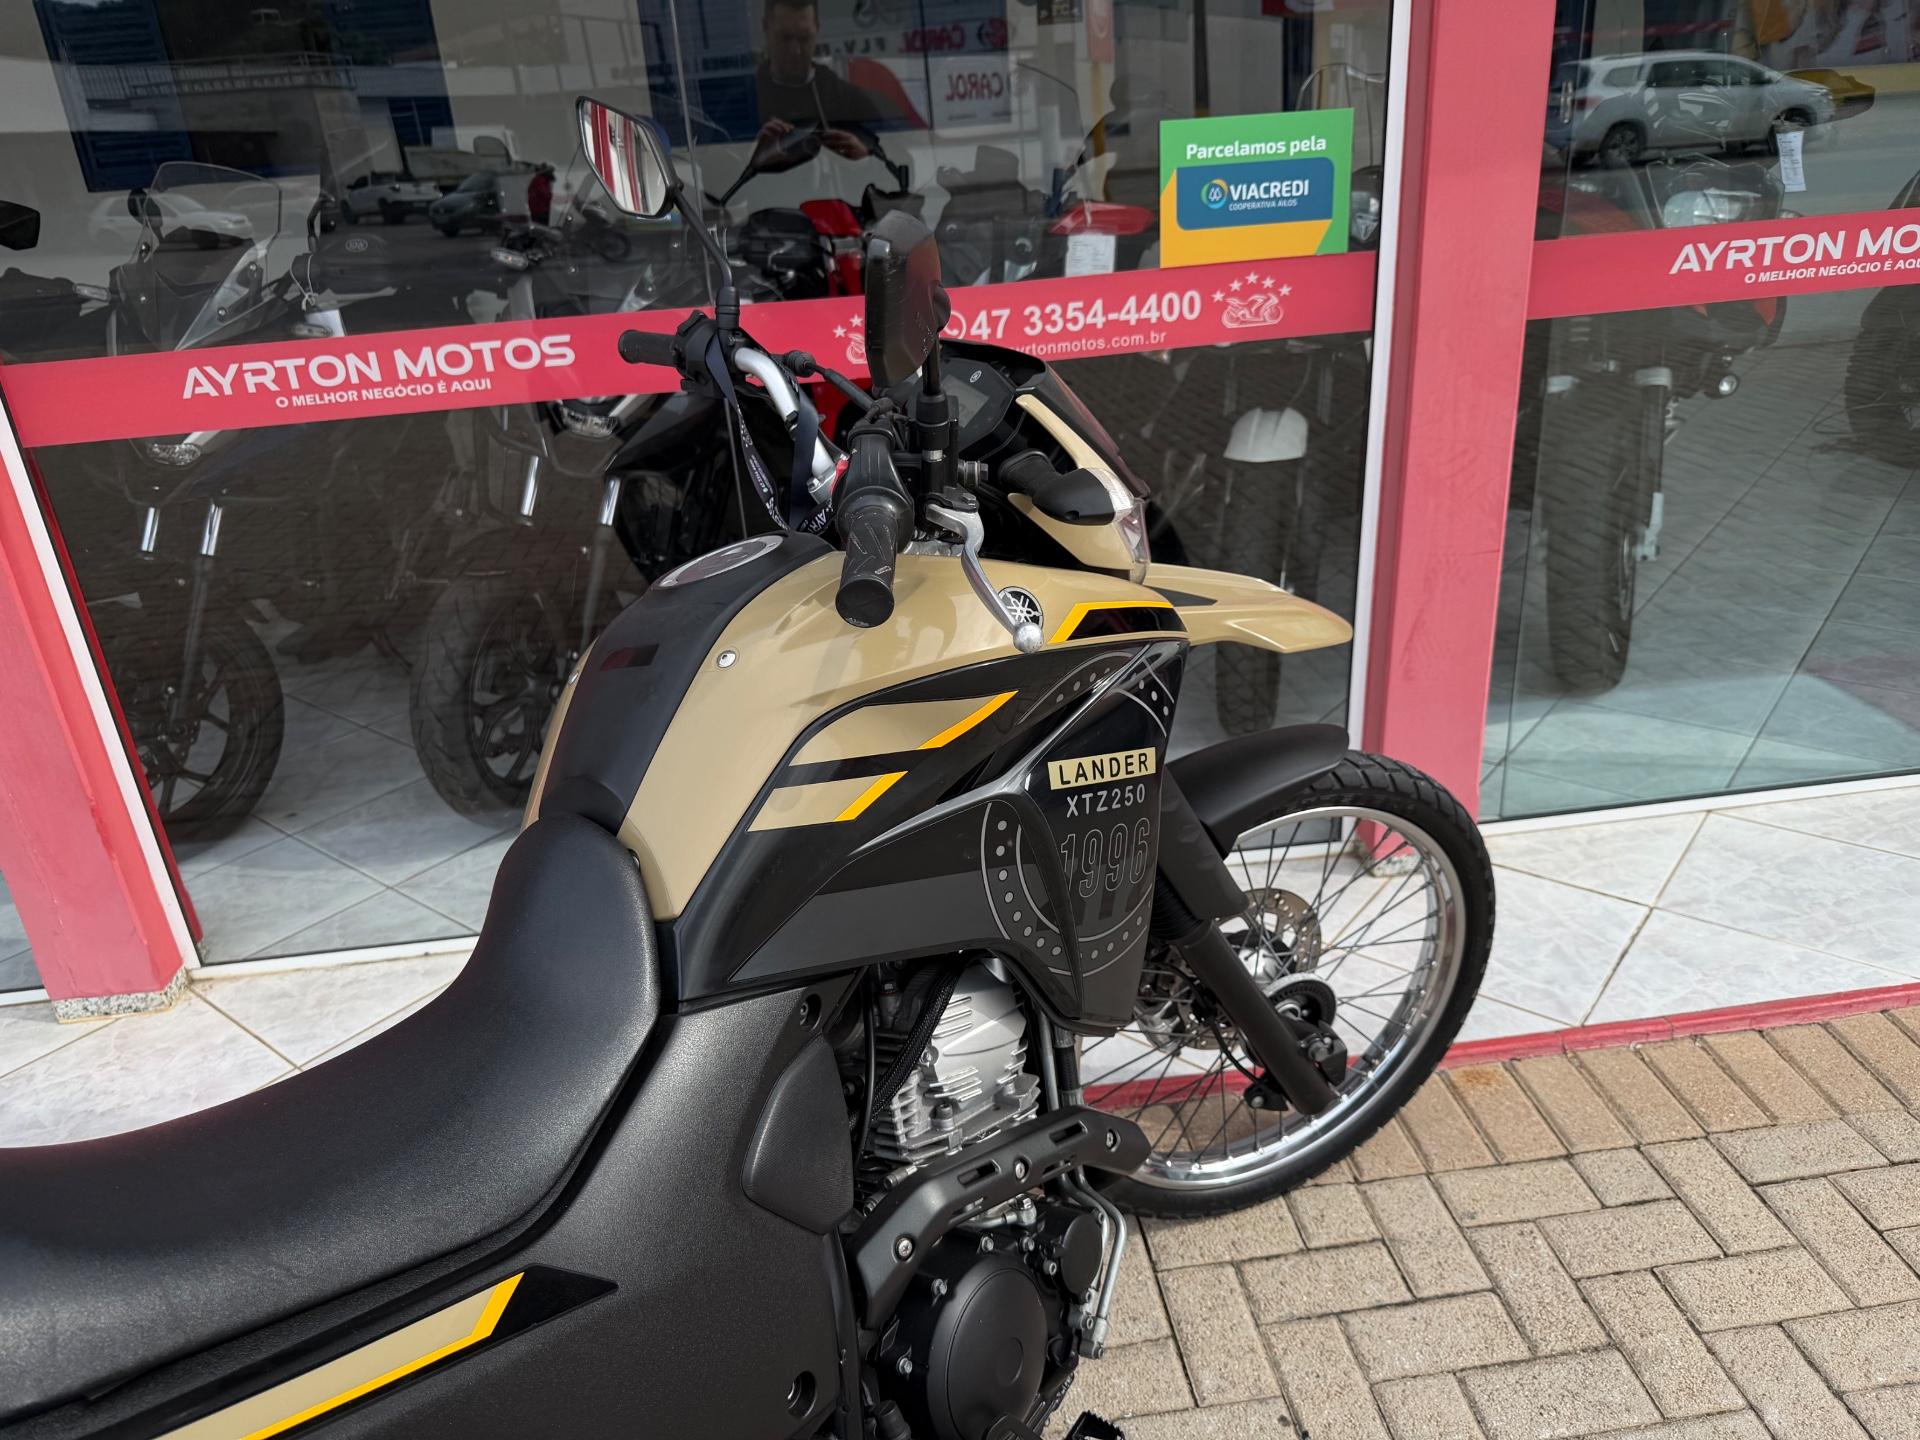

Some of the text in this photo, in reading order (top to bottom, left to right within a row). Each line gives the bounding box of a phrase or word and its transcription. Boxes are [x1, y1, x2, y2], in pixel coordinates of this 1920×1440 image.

[1186, 135, 1327, 160] Parcelamos pela
[1228, 200, 1276, 212] COOPERATIVA
[1229, 179, 1310, 201] VIACREDI
[1668, 230, 1846, 275] AYRTON
[1744, 272, 1756, 284] O
[1758, 267, 1815, 283] MELHOR
[1818, 259, 1881, 277] NEGÓCIO
[1883, 257, 1892, 271] É
[969, 290, 1201, 341] 47 3354-4400
[1008, 330, 1167, 356] yrtonmotos.com.br
[182, 334, 576, 400] AYRTON MOTOS
[275, 378, 492, 408] O MELHOR NEGÓCIO É AQUI
[1058, 752, 1149, 786] LANDER
[1066, 783, 1147, 818] XTZ250
[1060, 817, 1151, 898] 1996
